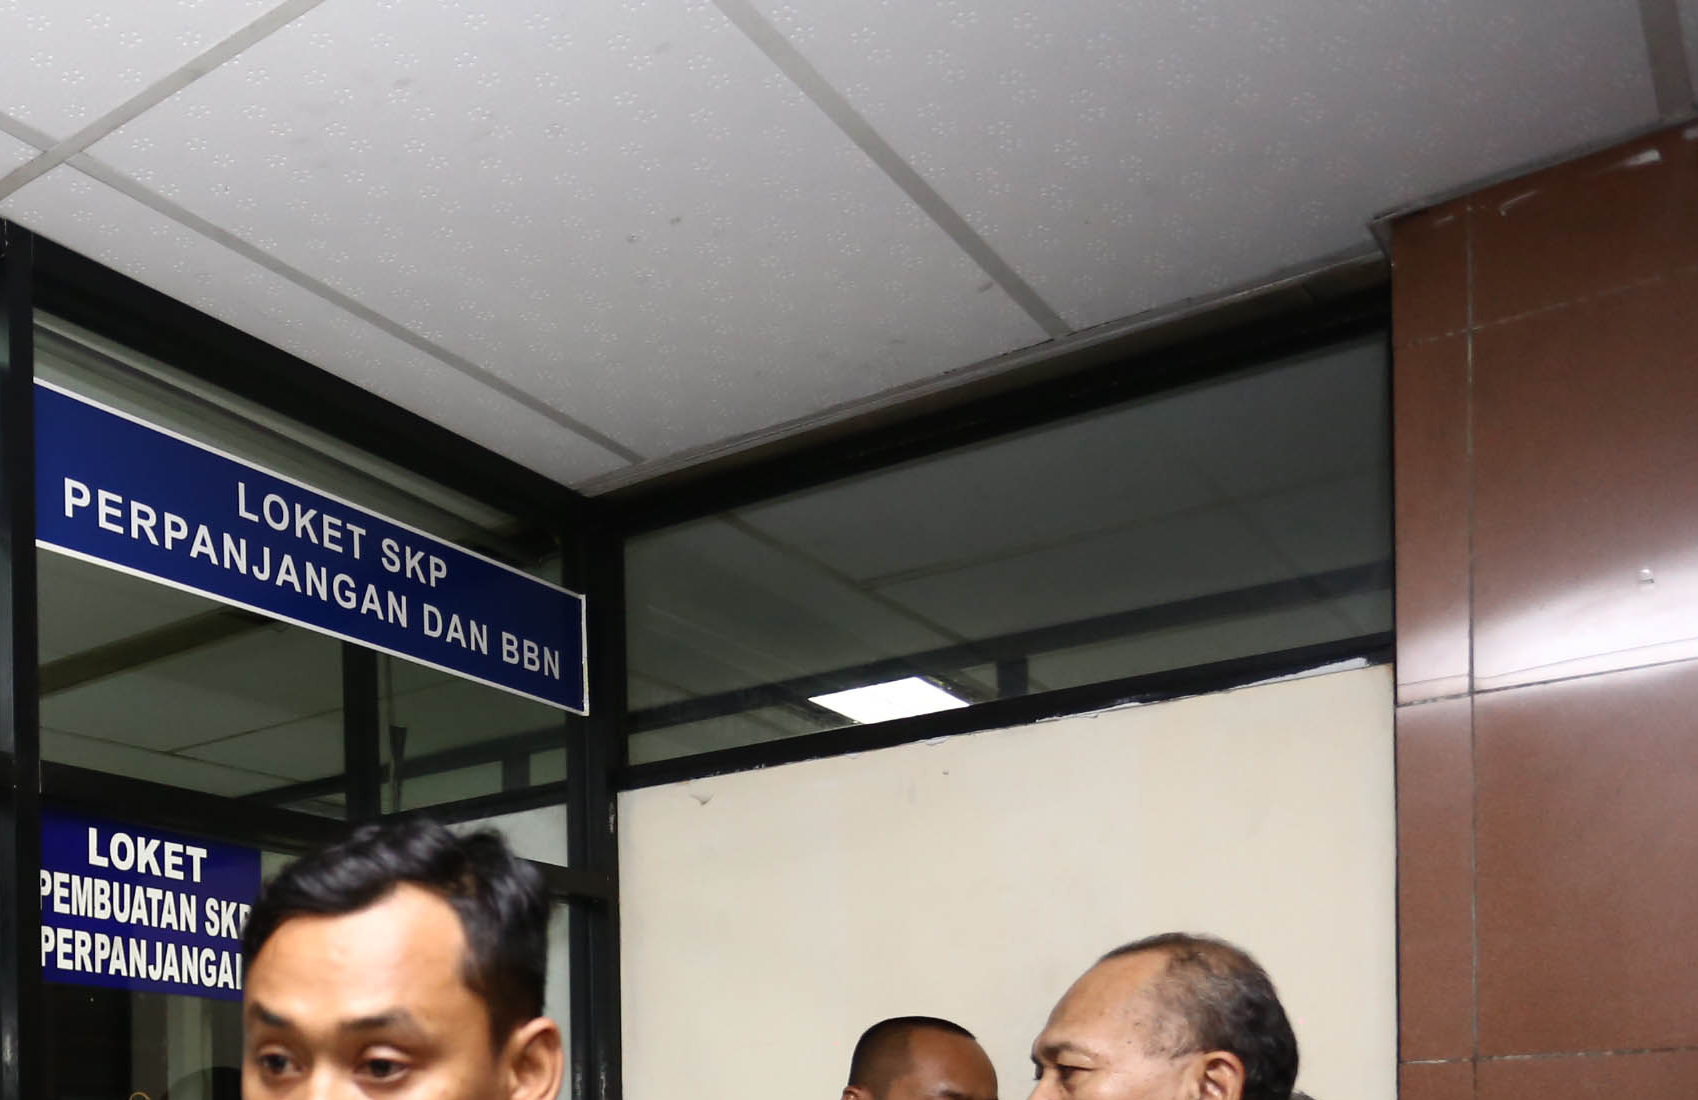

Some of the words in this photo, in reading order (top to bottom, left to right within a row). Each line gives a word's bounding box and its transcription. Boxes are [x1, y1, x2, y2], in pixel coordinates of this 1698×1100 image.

[63, 477, 409, 628] PERPANJANGAN
[423, 603, 489, 655] DAN
[502, 630, 560, 680] BBN
[237, 482, 366, 559] LOKET
[381, 538, 448, 588] SKP
[88, 827, 208, 883] LOKET
